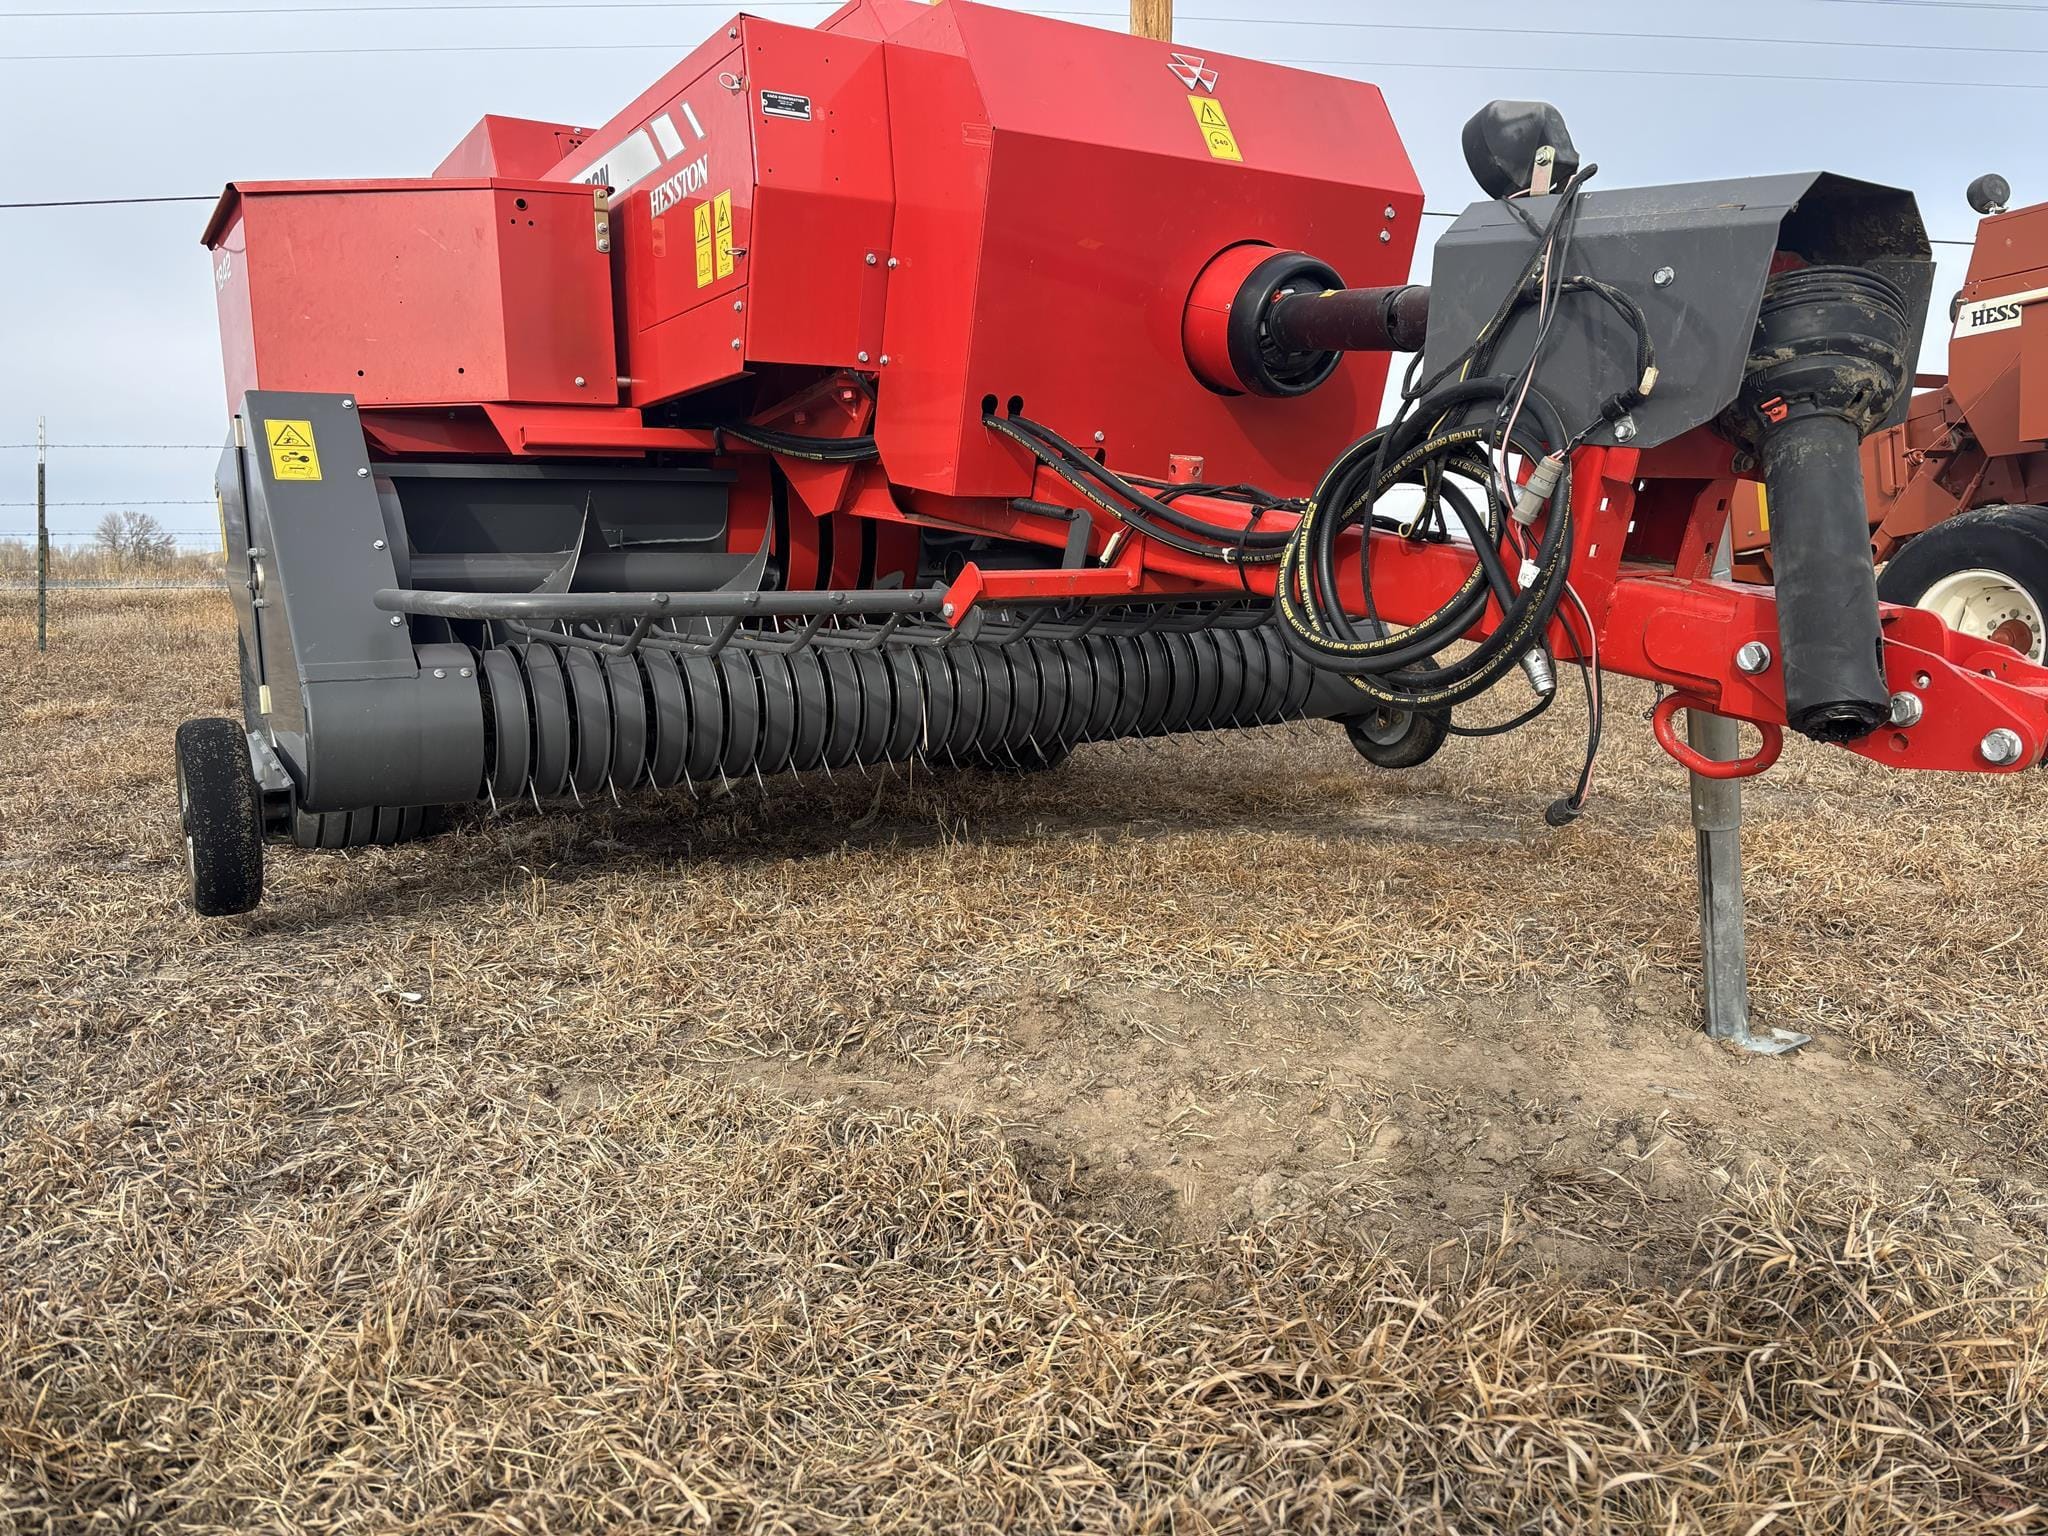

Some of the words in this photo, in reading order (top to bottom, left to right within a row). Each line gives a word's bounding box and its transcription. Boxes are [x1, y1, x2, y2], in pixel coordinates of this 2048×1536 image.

[650, 153, 708, 220] HESSTON
[1424, 437, 1447, 452] COVER
[1448, 429, 1477, 442] TOUGH
[1299, 529, 1308, 562] TOUGH
[1299, 563, 1308, 591] COVER
[1280, 597, 1294, 620] COVER
[1310, 634, 1320, 642] WP
[1320, 639, 1333, 648] 21.0
[1333, 642, 1348, 650] MPa
[1349, 642, 1368, 650] (3000
[1369, 640, 1384, 649] PSI)
[1385, 632, 1408, 645] MSHA
[1417, 695, 1430, 704] SAE
